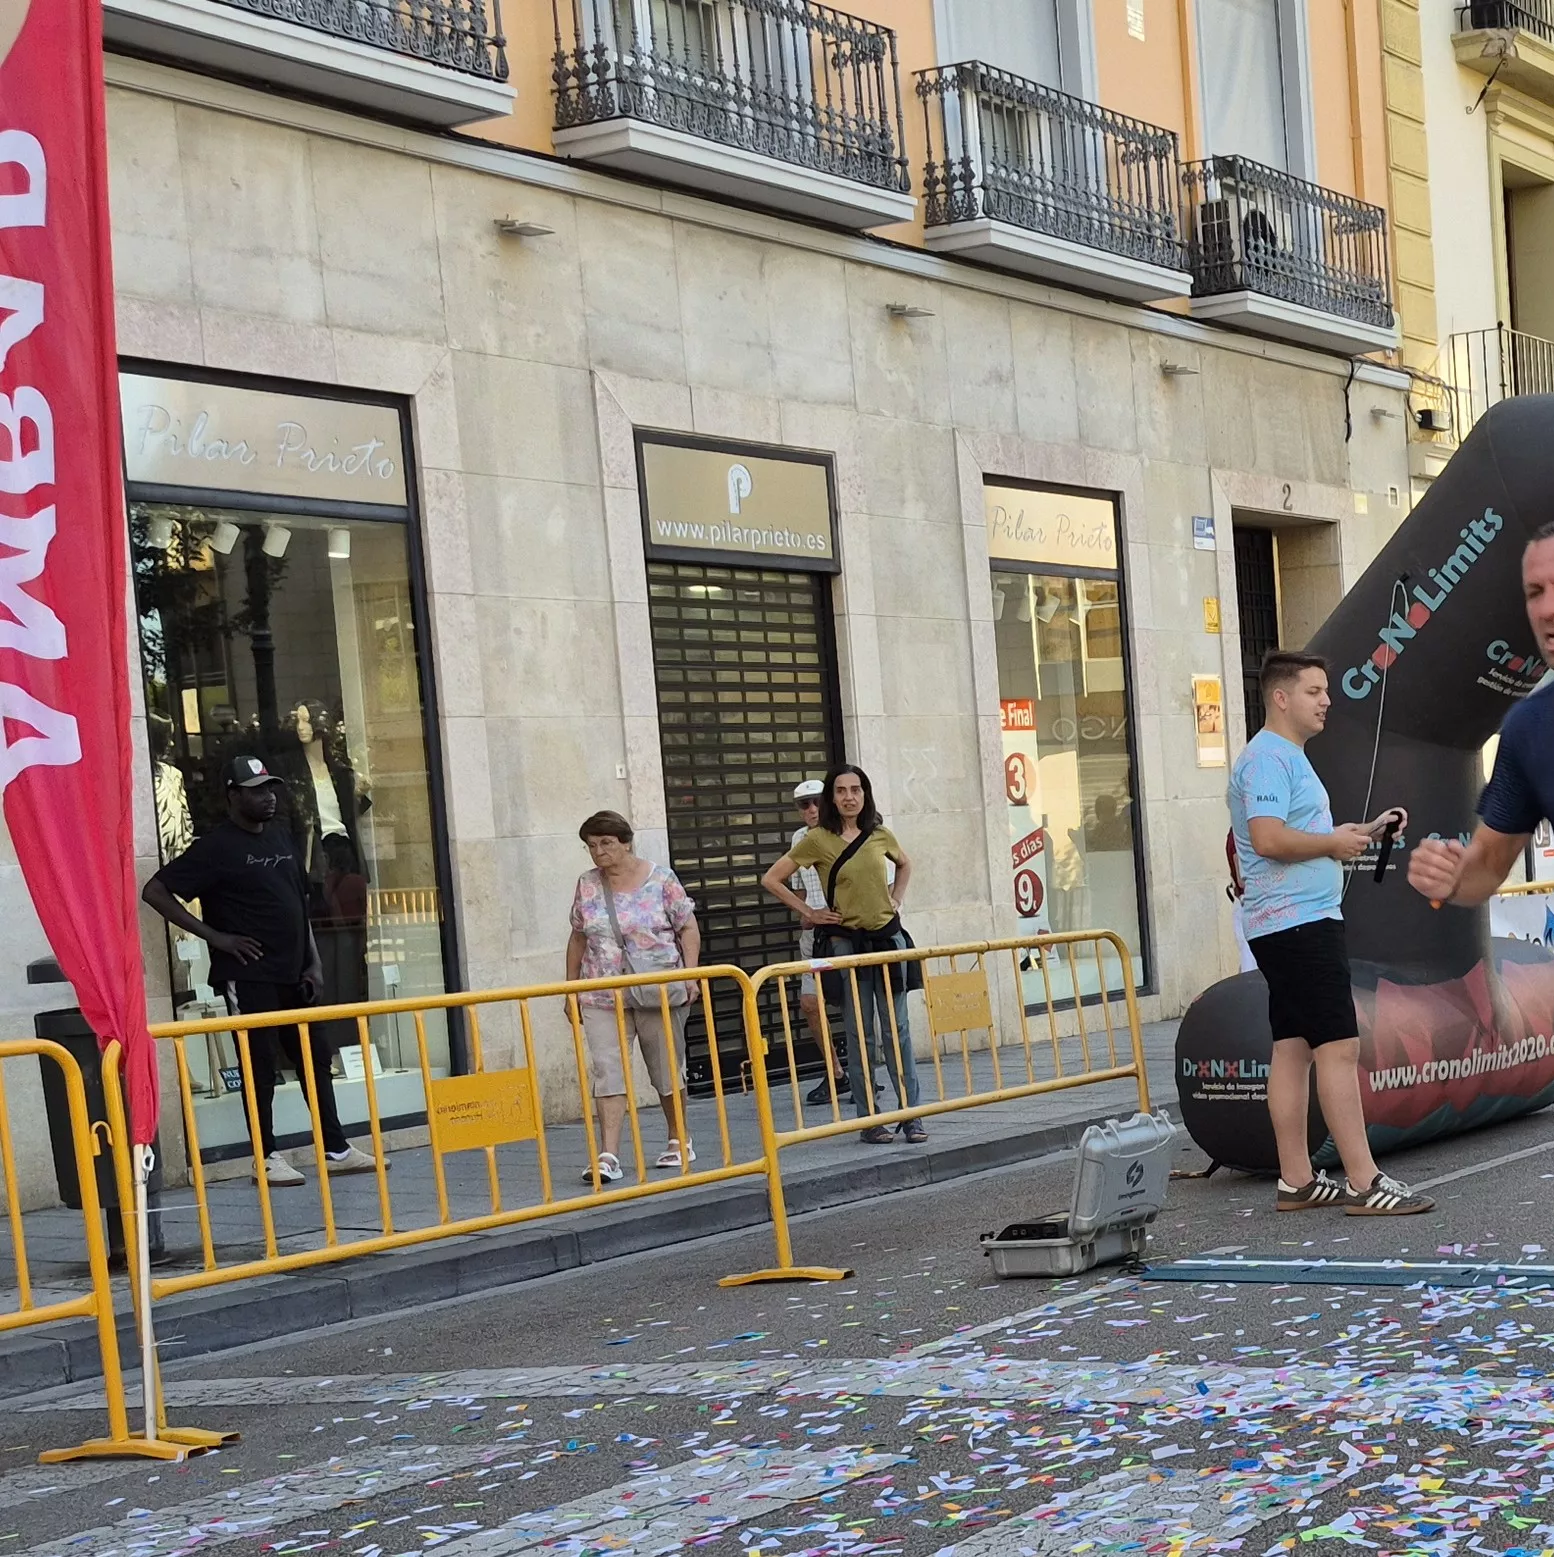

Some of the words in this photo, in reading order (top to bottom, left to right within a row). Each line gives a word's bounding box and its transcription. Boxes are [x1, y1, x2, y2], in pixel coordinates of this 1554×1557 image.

[137, 404, 257, 465] Pilar
[276, 421, 395, 480] Prieto
[1282, 485, 1293, 511] 2
[656, 519, 826, 550] www.pilarprieto.es
[991, 505, 1046, 544] Pilar
[1055, 513, 1112, 552] Prieto
[1007, 700, 1034, 727] Final
[1008, 756, 1026, 800] 3
[1020, 836, 1044, 859] días
